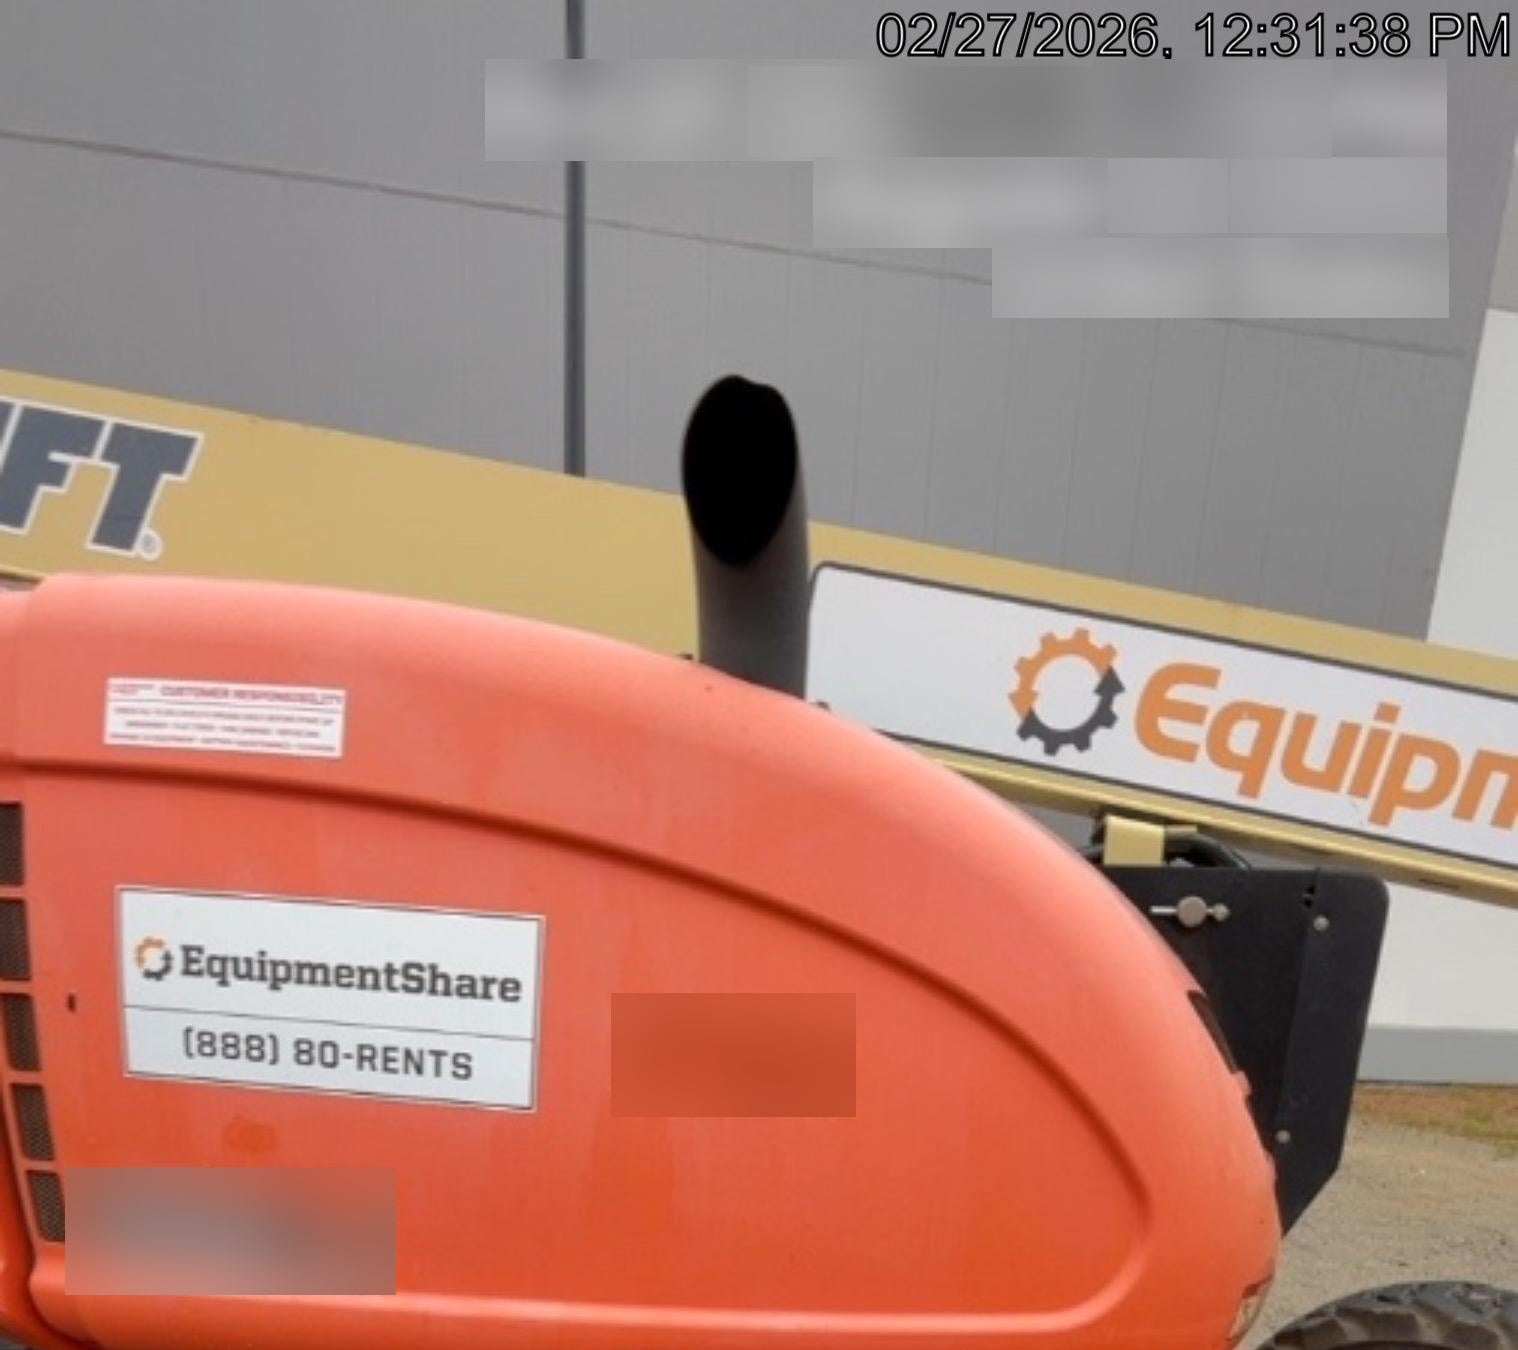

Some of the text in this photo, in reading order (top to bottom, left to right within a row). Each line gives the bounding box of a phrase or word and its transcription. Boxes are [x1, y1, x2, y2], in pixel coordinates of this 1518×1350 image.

[0, 397, 203, 557] FT
[179, 944, 522, 1002] EquipmentShare
[183, 1027, 473, 1080] (888) 80-RENTS
